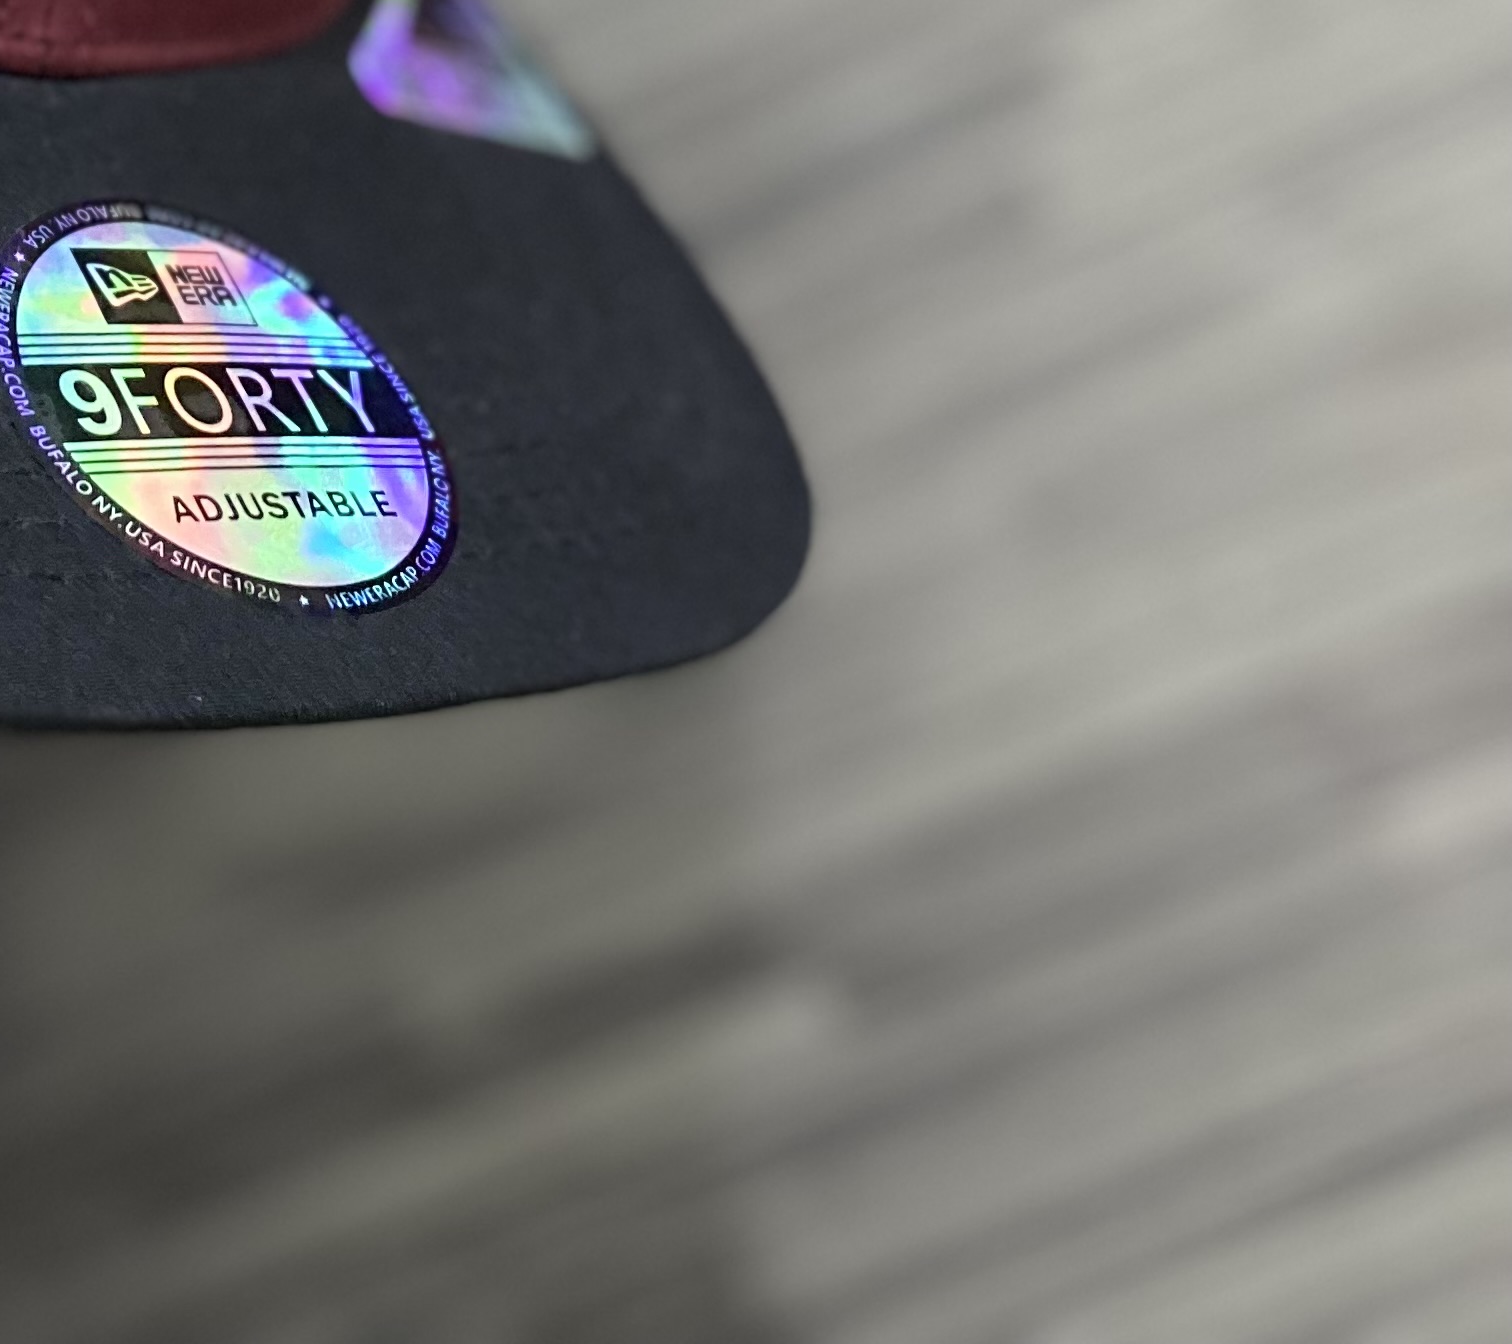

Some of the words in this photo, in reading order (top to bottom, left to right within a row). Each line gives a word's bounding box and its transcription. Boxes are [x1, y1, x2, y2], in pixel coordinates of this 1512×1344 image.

[165, 264, 226, 286] NEW
[177, 285, 238, 307] ERA
[58, 366, 376, 436] 9FORTY
[172, 490, 398, 523] ADJUSTABLE
